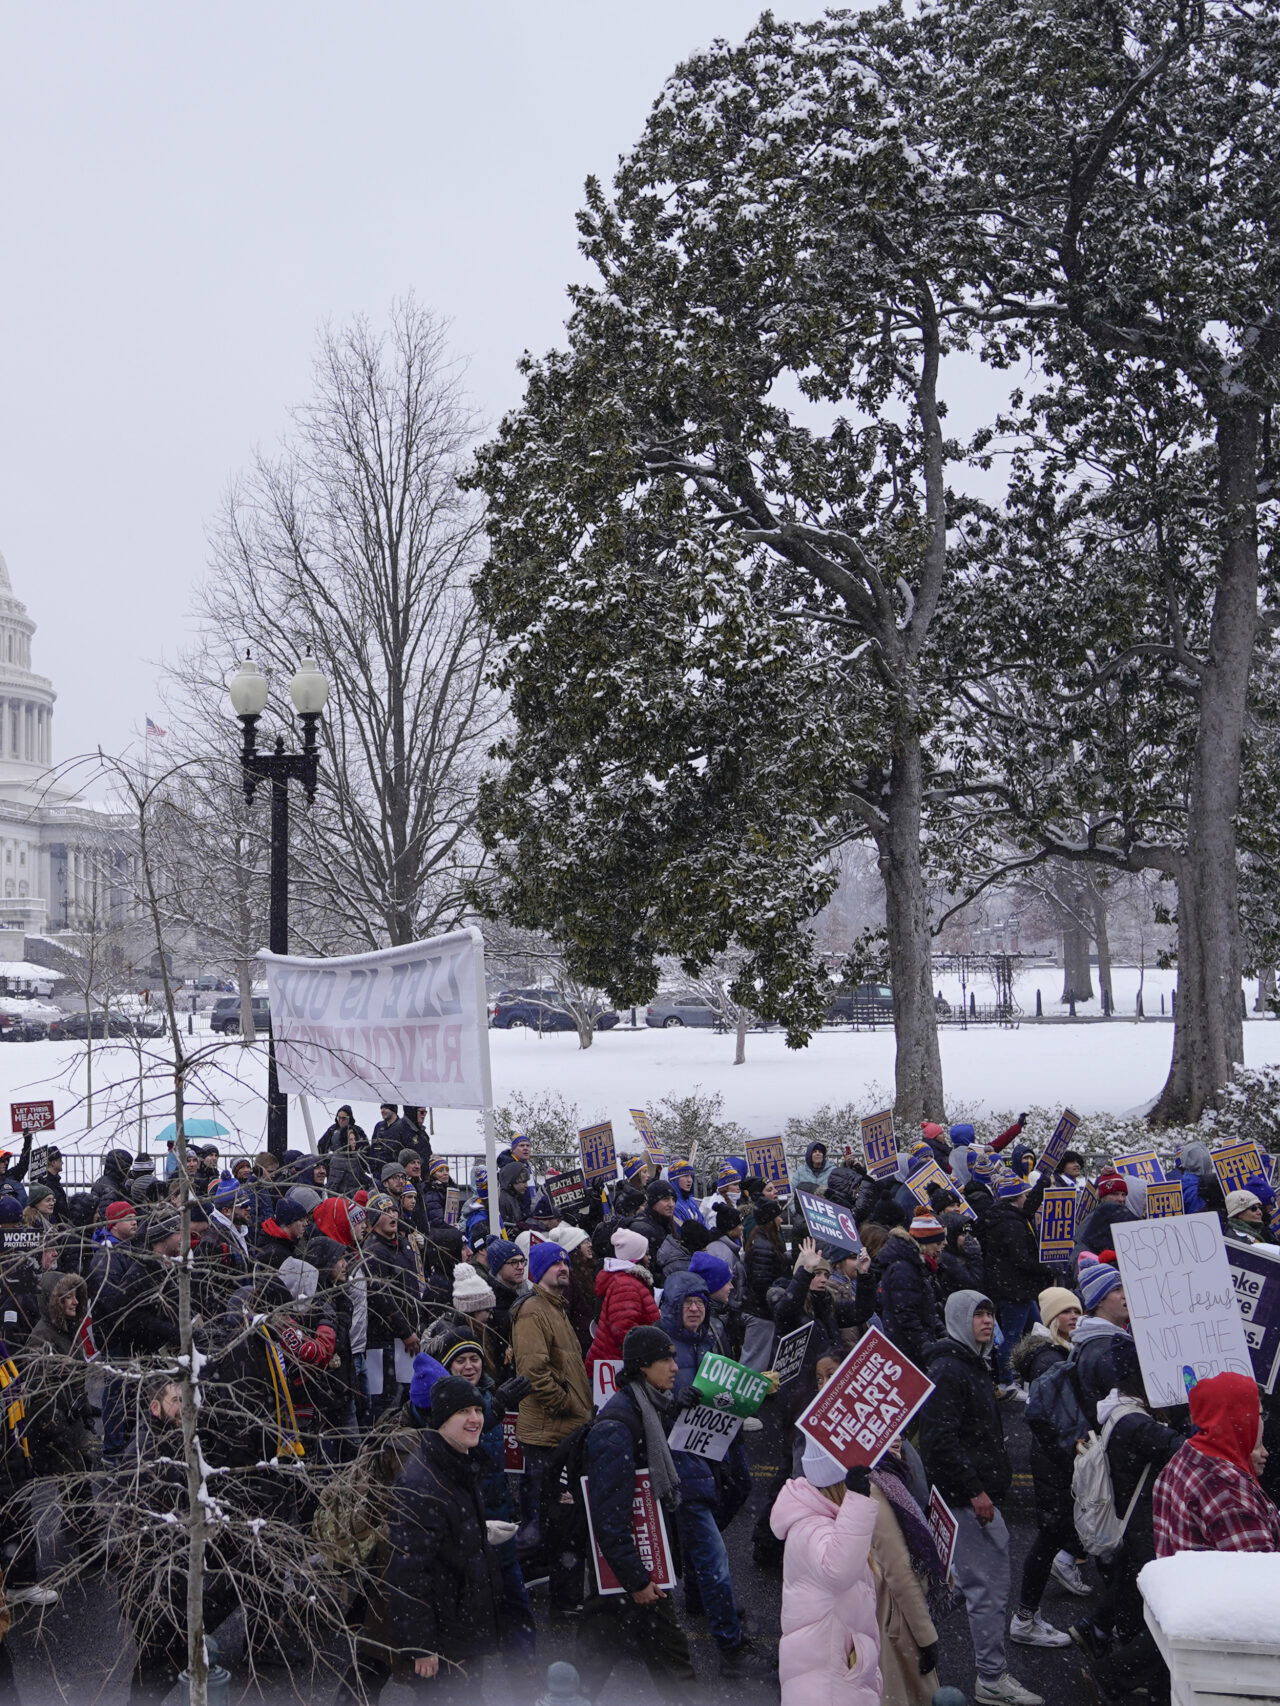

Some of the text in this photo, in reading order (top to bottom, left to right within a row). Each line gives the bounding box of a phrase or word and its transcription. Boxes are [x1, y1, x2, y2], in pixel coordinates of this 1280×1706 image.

[14, 1112, 52, 1122] HEARTS
[16, 1106, 29, 1114] LET
[29, 1105, 49, 1113] THEIR
[21, 1120, 46, 1129] BEAT
[583, 1146, 617, 1172] LIFE
[864, 1135, 897, 1163] LIFE
[1216, 1152, 1261, 1180] DEFEND
[549, 1178, 571, 1191] DEATH
[572, 1175, 581, 1184] IS
[553, 1188, 586, 1207] HERE!
[802, 1195, 837, 1219] LIFE
[1045, 1200, 1073, 1220] PRO
[1148, 1192, 1182, 1214] DEFEND
[4, 1232, 40, 1242] WORTH
[809, 1220, 844, 1240] LIVING
[1043, 1220, 1072, 1240] LIFE
[1117, 1221, 1217, 1272] RESPOND
[1126, 1270, 1235, 1320] LIKE Jesus
[1232, 1271, 1259, 1296] ake
[1146, 1323, 1185, 1362] NOT
[1191, 1318, 1237, 1354] THE
[701, 1354, 740, 1391] LOVE
[735, 1372, 768, 1402] LIFE
[815, 1337, 878, 1417] STUDENTSFORLIFEACTION.ORG
[820, 1352, 886, 1433] LET THEIR
[829, 1360, 903, 1451] HEARTS
[683, 1405, 738, 1436] CHOOSE
[855, 1387, 906, 1451] BEAT
[684, 1429, 714, 1454] LIFE
